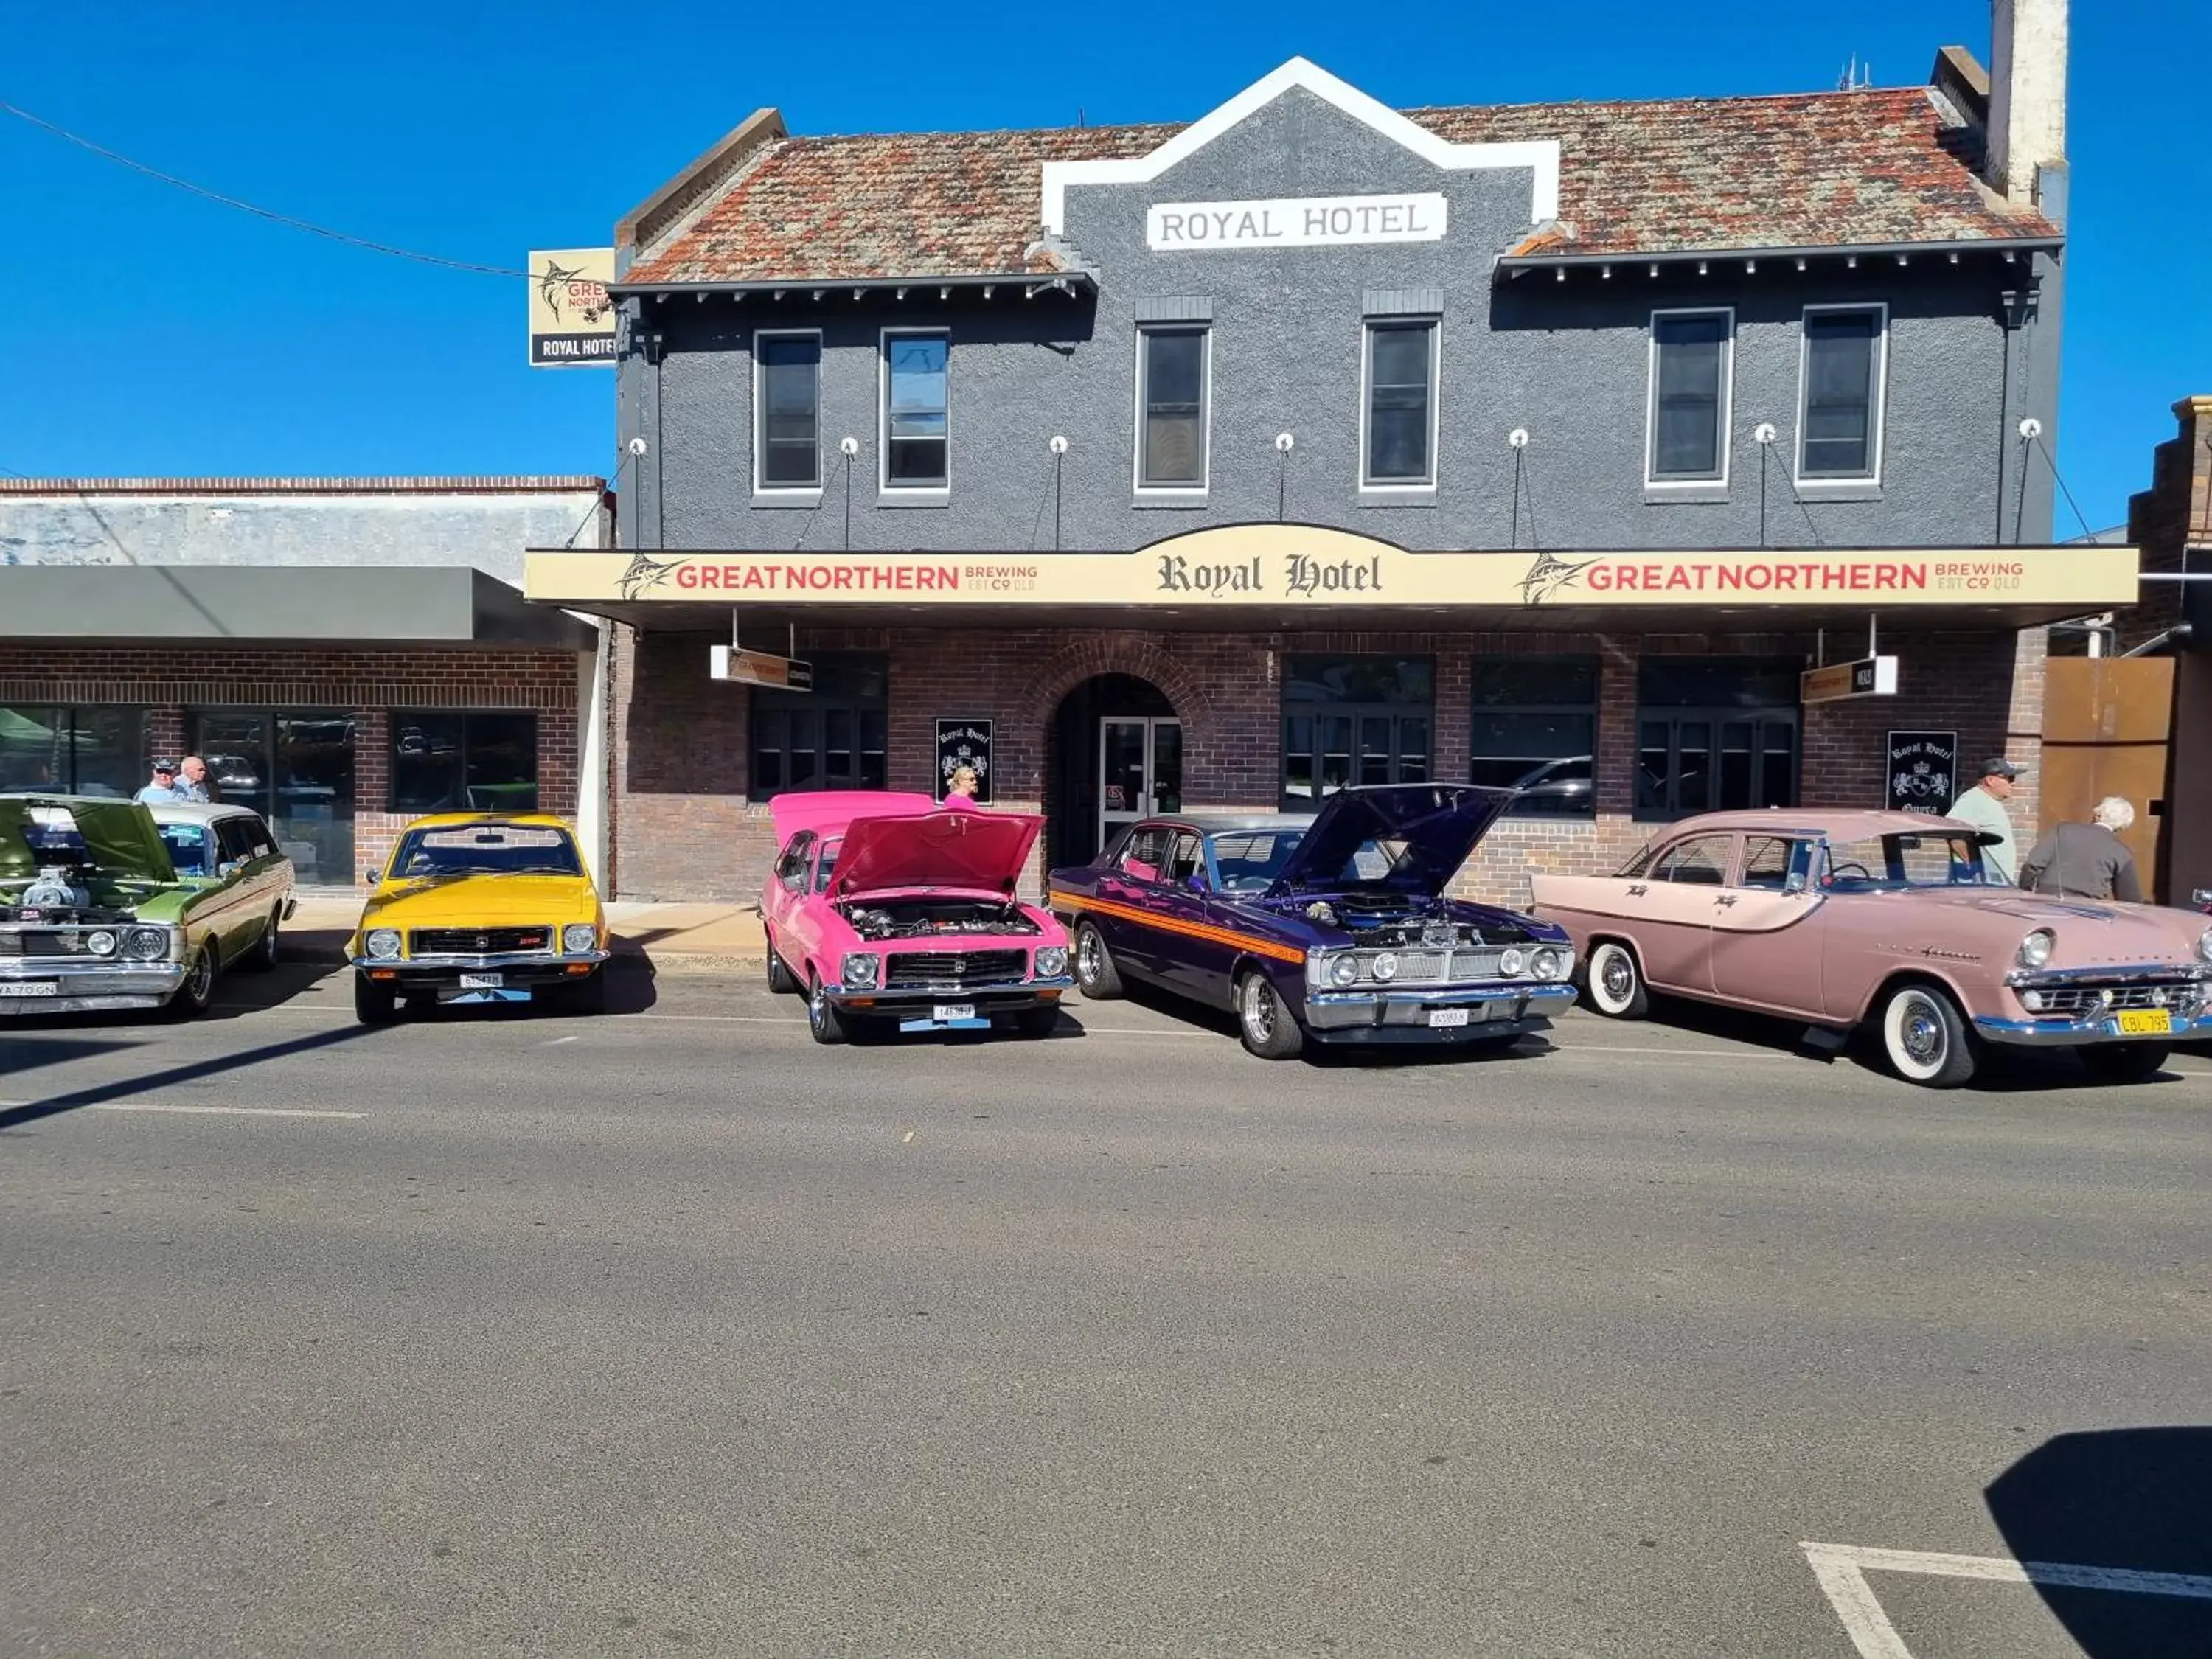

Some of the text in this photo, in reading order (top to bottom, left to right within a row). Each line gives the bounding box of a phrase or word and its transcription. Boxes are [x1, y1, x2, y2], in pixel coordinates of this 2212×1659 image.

[1161, 205, 1429, 241] ROYAL HOTEL
[568, 283, 608, 297] GRE
[543, 340, 580, 356] ROYAL
[965, 566, 1037, 577] BREWING
[1156, 554, 1382, 598] Royal Hotel
[1935, 563, 2023, 576] BREWING
